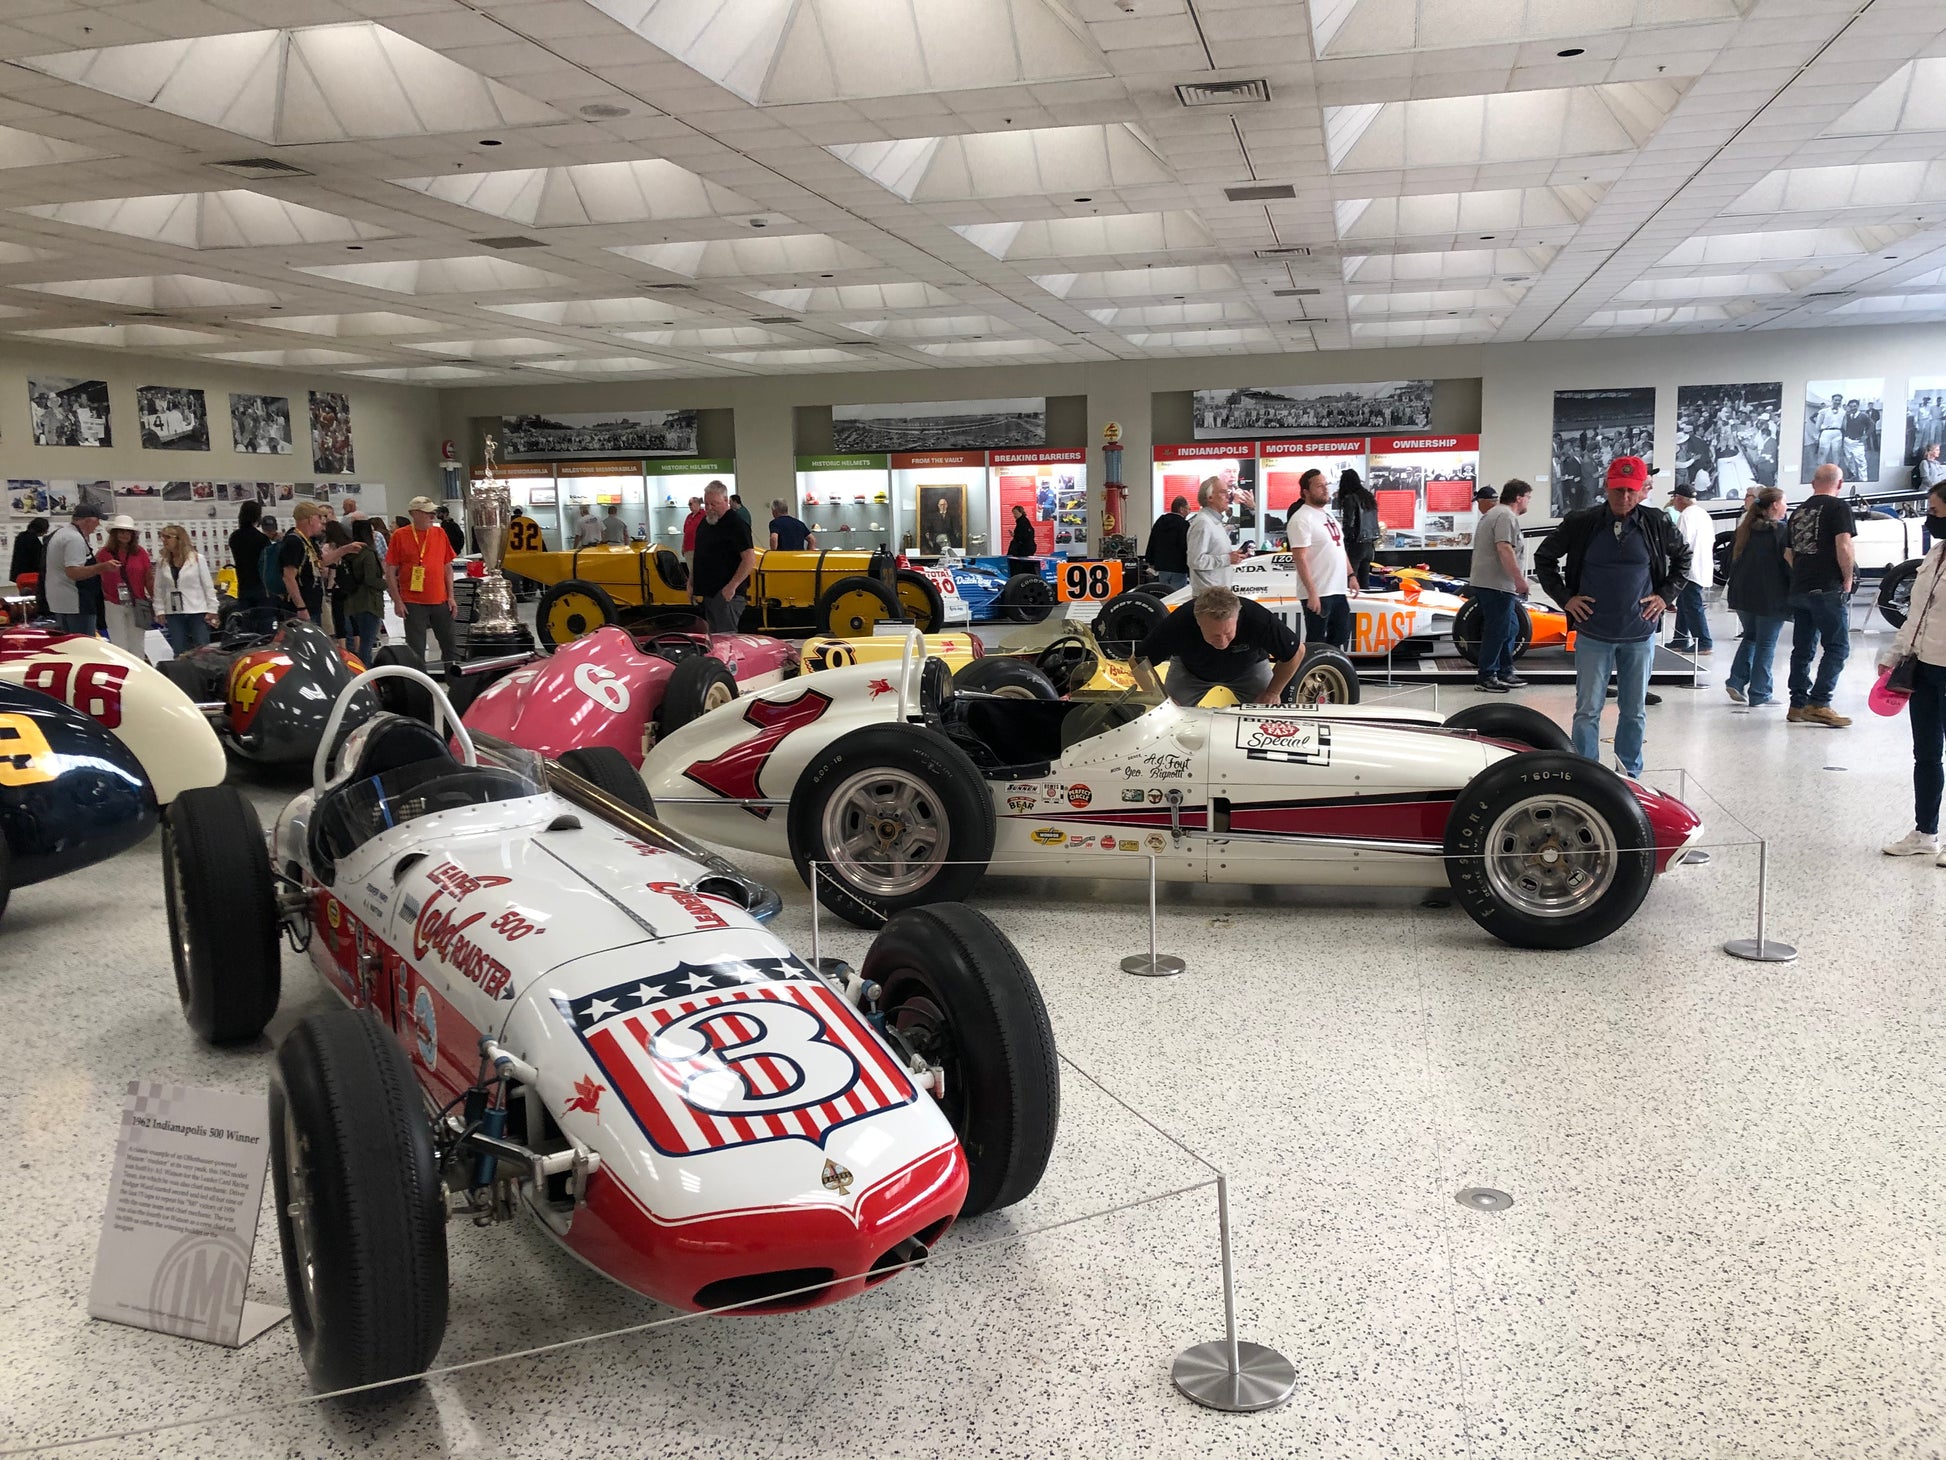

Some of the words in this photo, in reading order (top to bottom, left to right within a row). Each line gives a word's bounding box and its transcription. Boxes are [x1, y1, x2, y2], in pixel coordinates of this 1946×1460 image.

[1265, 444, 1304, 453] MOTOR
[1305, 441, 1360, 452] SPEEDWAY
[1392, 439, 1457, 448] OWNERSHIP
[994, 454, 1038, 462] BREAKING
[1039, 452, 1081, 461] BARRIERS
[1177, 446, 1249, 456] INDIANAPOLIS
[943, 456, 964, 464] VAULT
[510, 522, 540, 550] 32
[1272, 555, 1294, 563] IZO
[955, 575, 977, 585] Dutch
[1066, 563, 1111, 600] 98
[1355, 611, 1417, 653] RAST
[574, 663, 630, 713] 6
[1266, 728, 1296, 736] FAST
[1246, 732, 1312, 748] Special
[1164, 753, 1192, 773] Foyt
[1122, 766, 1143, 780] Geo.
[1149, 767, 1184, 781] Bignotti
[1006, 784, 1039, 792] SUNNEN
[1068, 788, 1091, 796] PERFECT
[1008, 800, 1035, 811] BEAR
[426, 861, 490, 902] LEADER
[413, 889, 487, 964] Card
[648, 999, 861, 1118] 3
[132, 1116, 151, 1128] 1962
[152, 1119, 207, 1137] Indianapolis
[209, 1127, 224, 1140] 500
[225, 1129, 260, 1145] Winner
